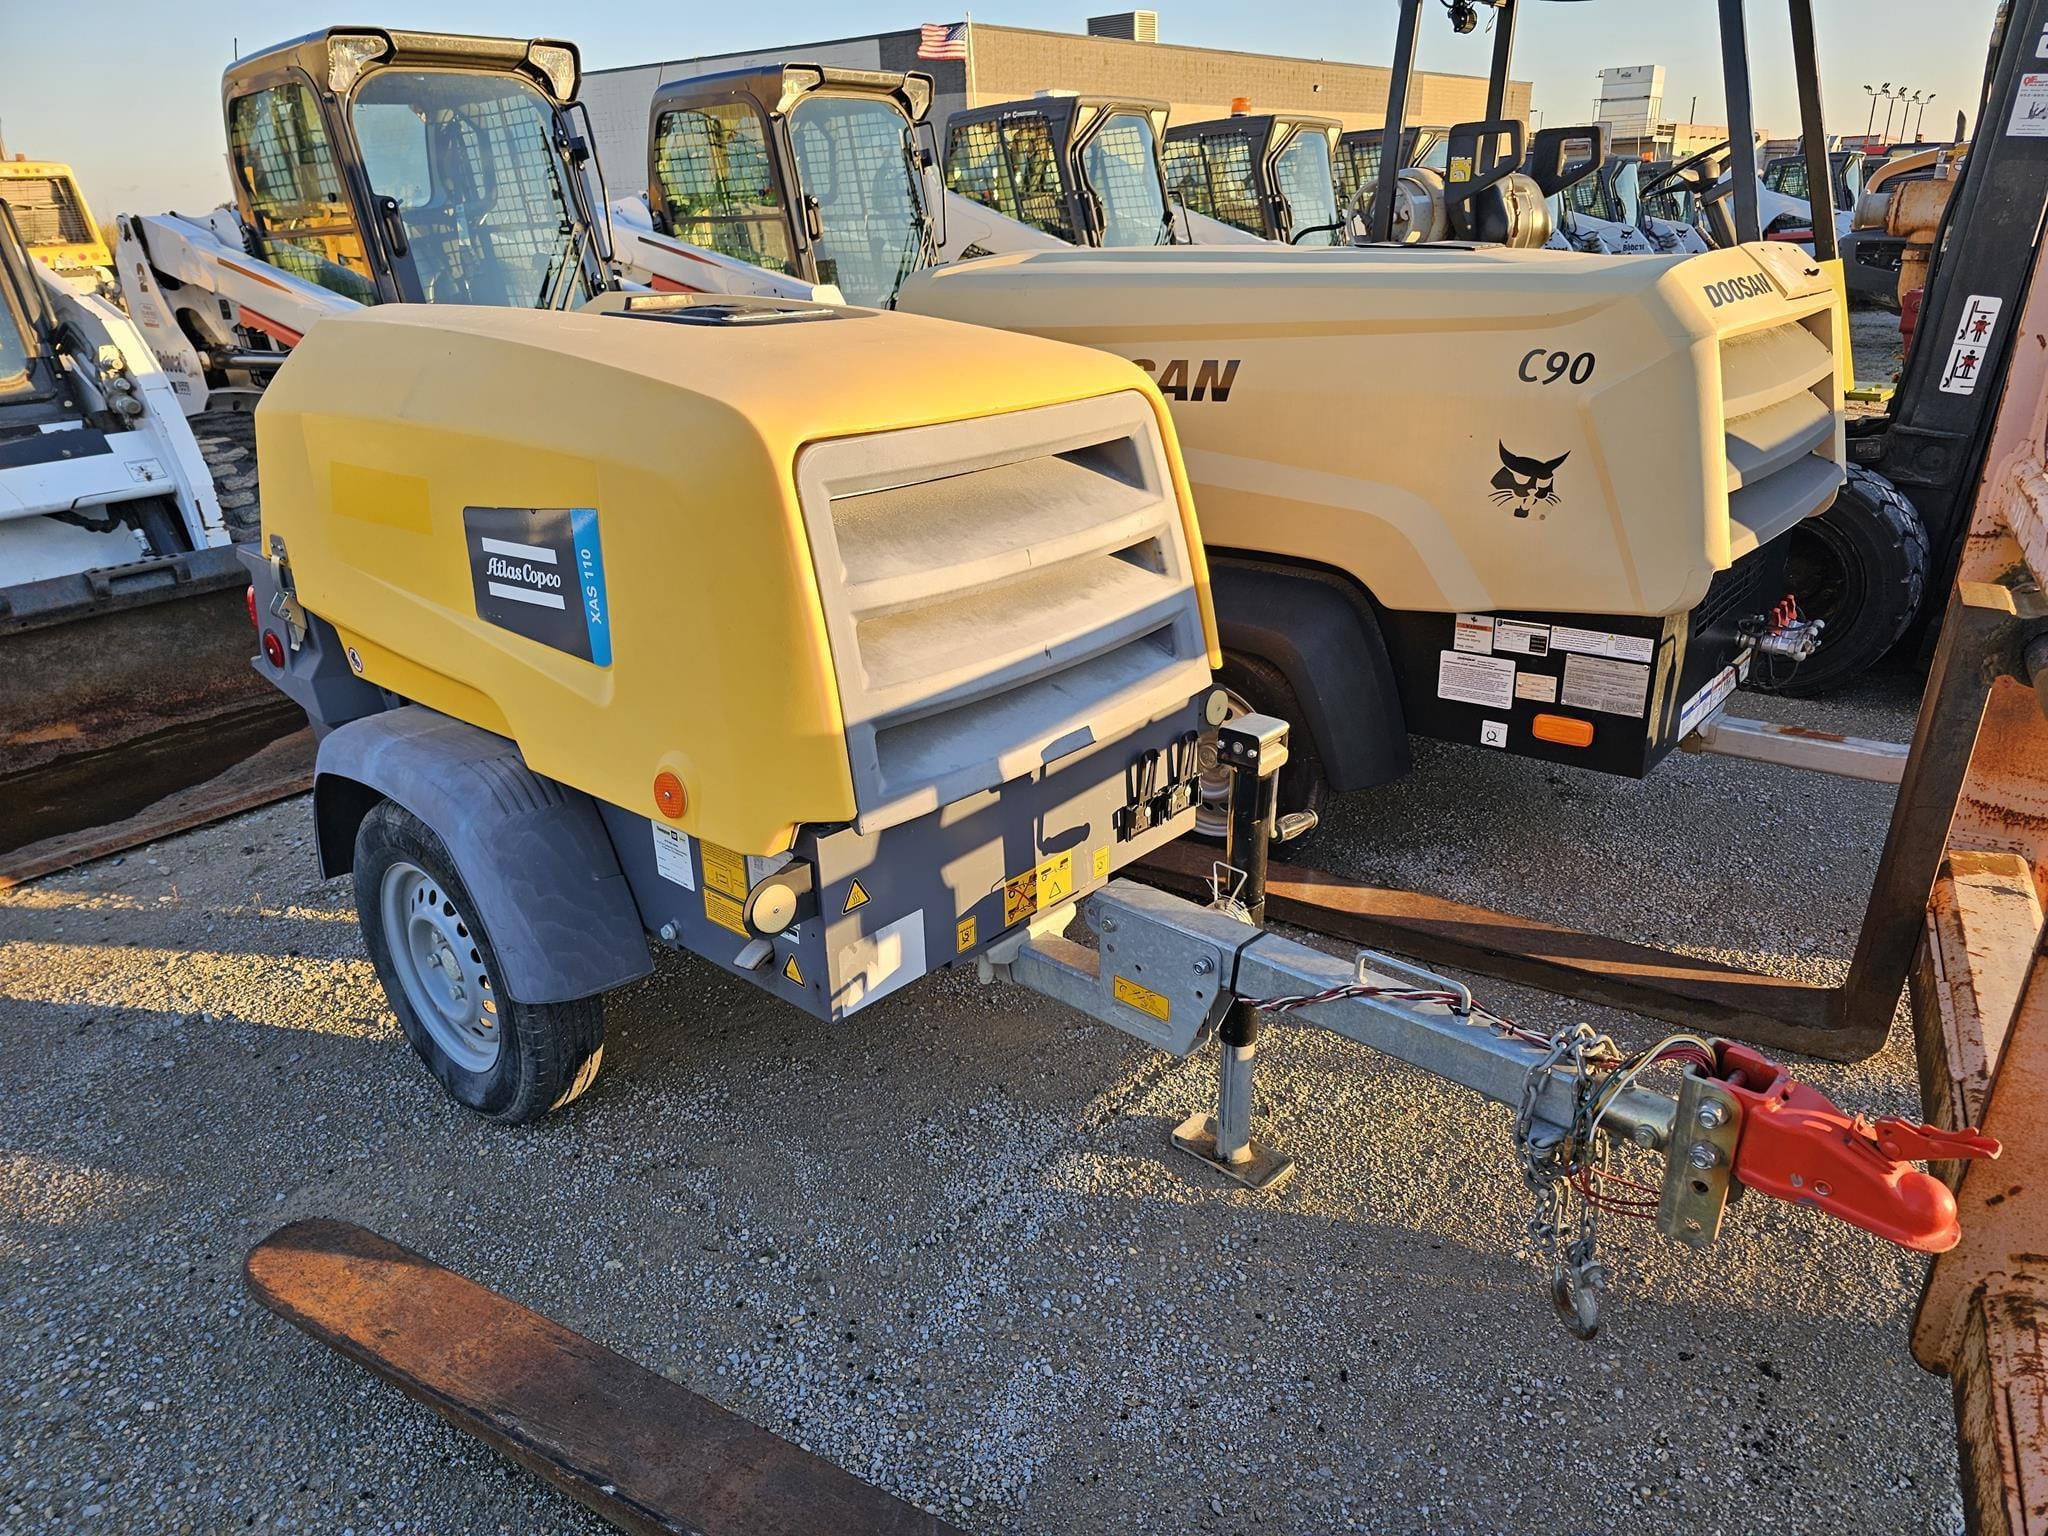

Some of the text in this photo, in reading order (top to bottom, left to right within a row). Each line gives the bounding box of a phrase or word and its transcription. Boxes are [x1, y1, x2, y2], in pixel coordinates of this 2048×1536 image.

[1703, 272, 1774, 308] DOOSAN
[1518, 348, 1596, 385] C90
[486, 556, 561, 588] Atlas Copco
[580, 548, 602, 625] XAS 110
